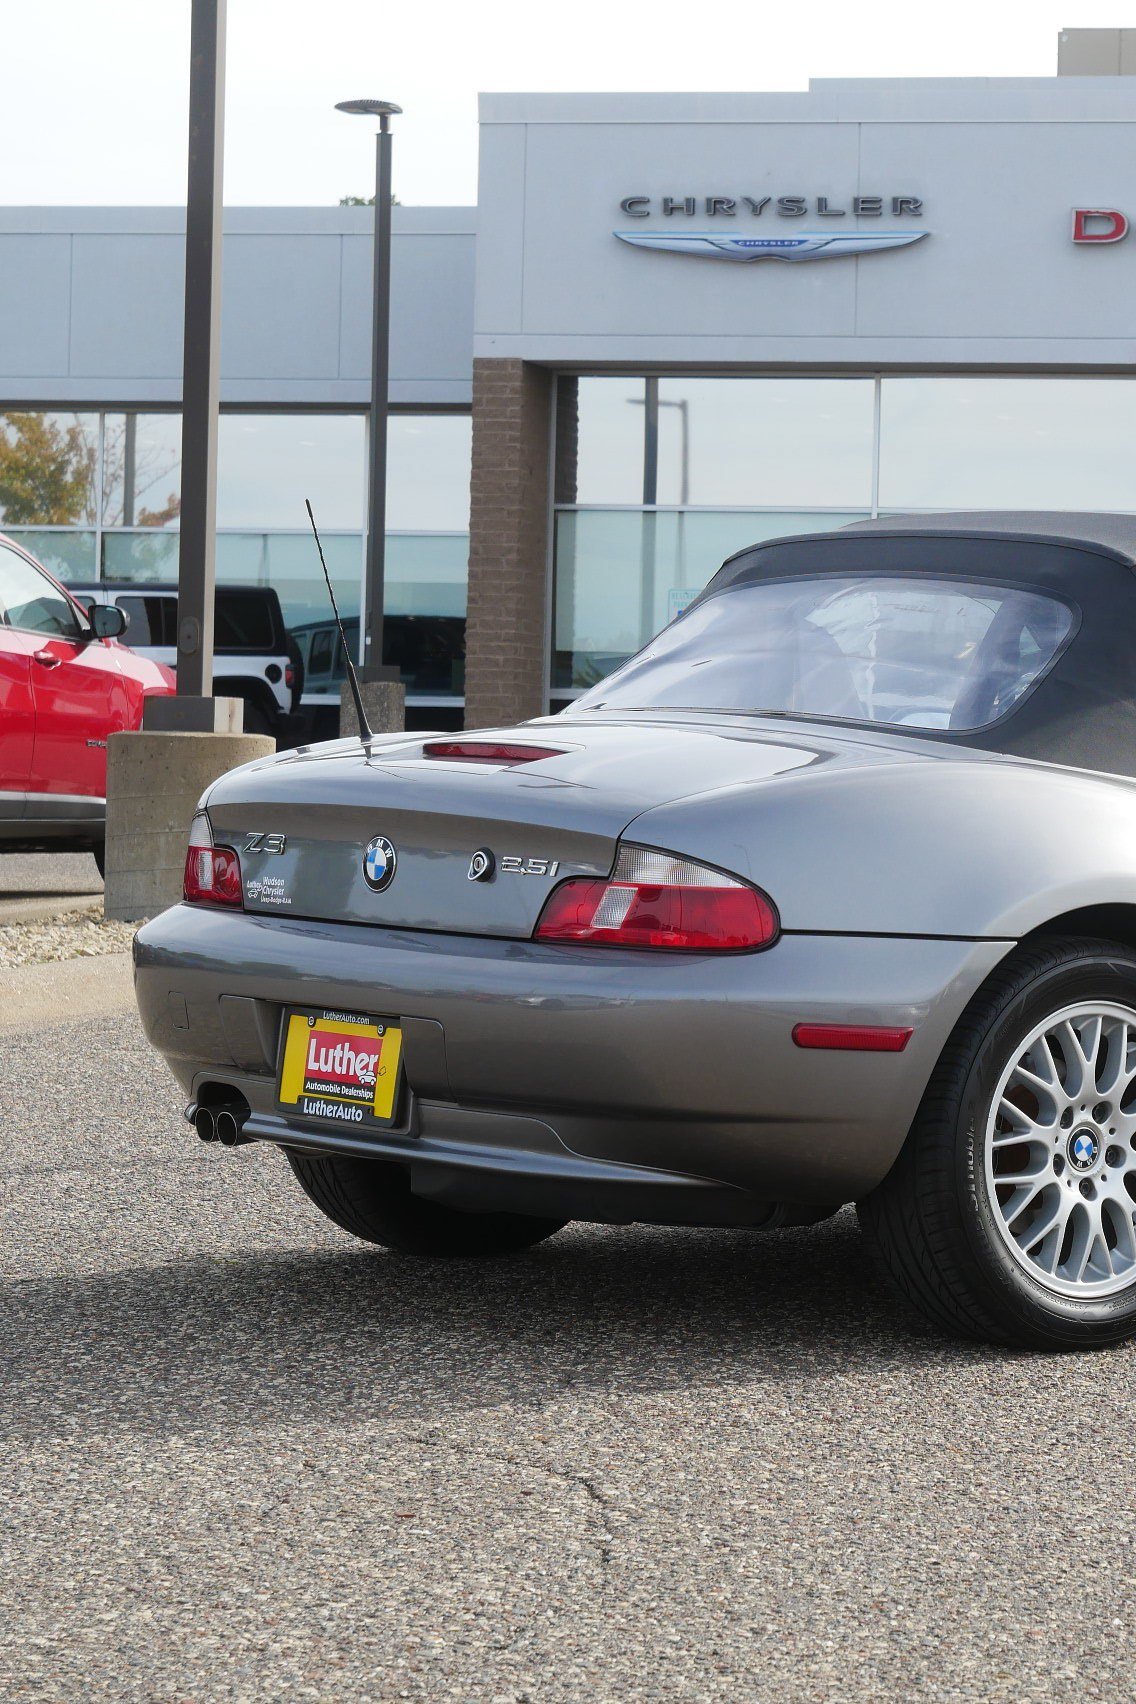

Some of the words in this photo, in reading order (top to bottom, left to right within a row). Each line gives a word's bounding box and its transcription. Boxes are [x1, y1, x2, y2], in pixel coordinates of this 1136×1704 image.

[620, 195, 924, 218] CHRYSLER
[243, 832, 287, 855] Z3
[263, 877, 285, 886] Hudson
[263, 886, 285, 896] Chrysler
[323, 1011, 370, 1025] LutherAuto.com
[308, 1038, 379, 1076] Luther
[306, 1081, 340, 1094] Automobile
[341, 1085, 374, 1100] Dealerships
[303, 1098, 363, 1121] LutherAuto
